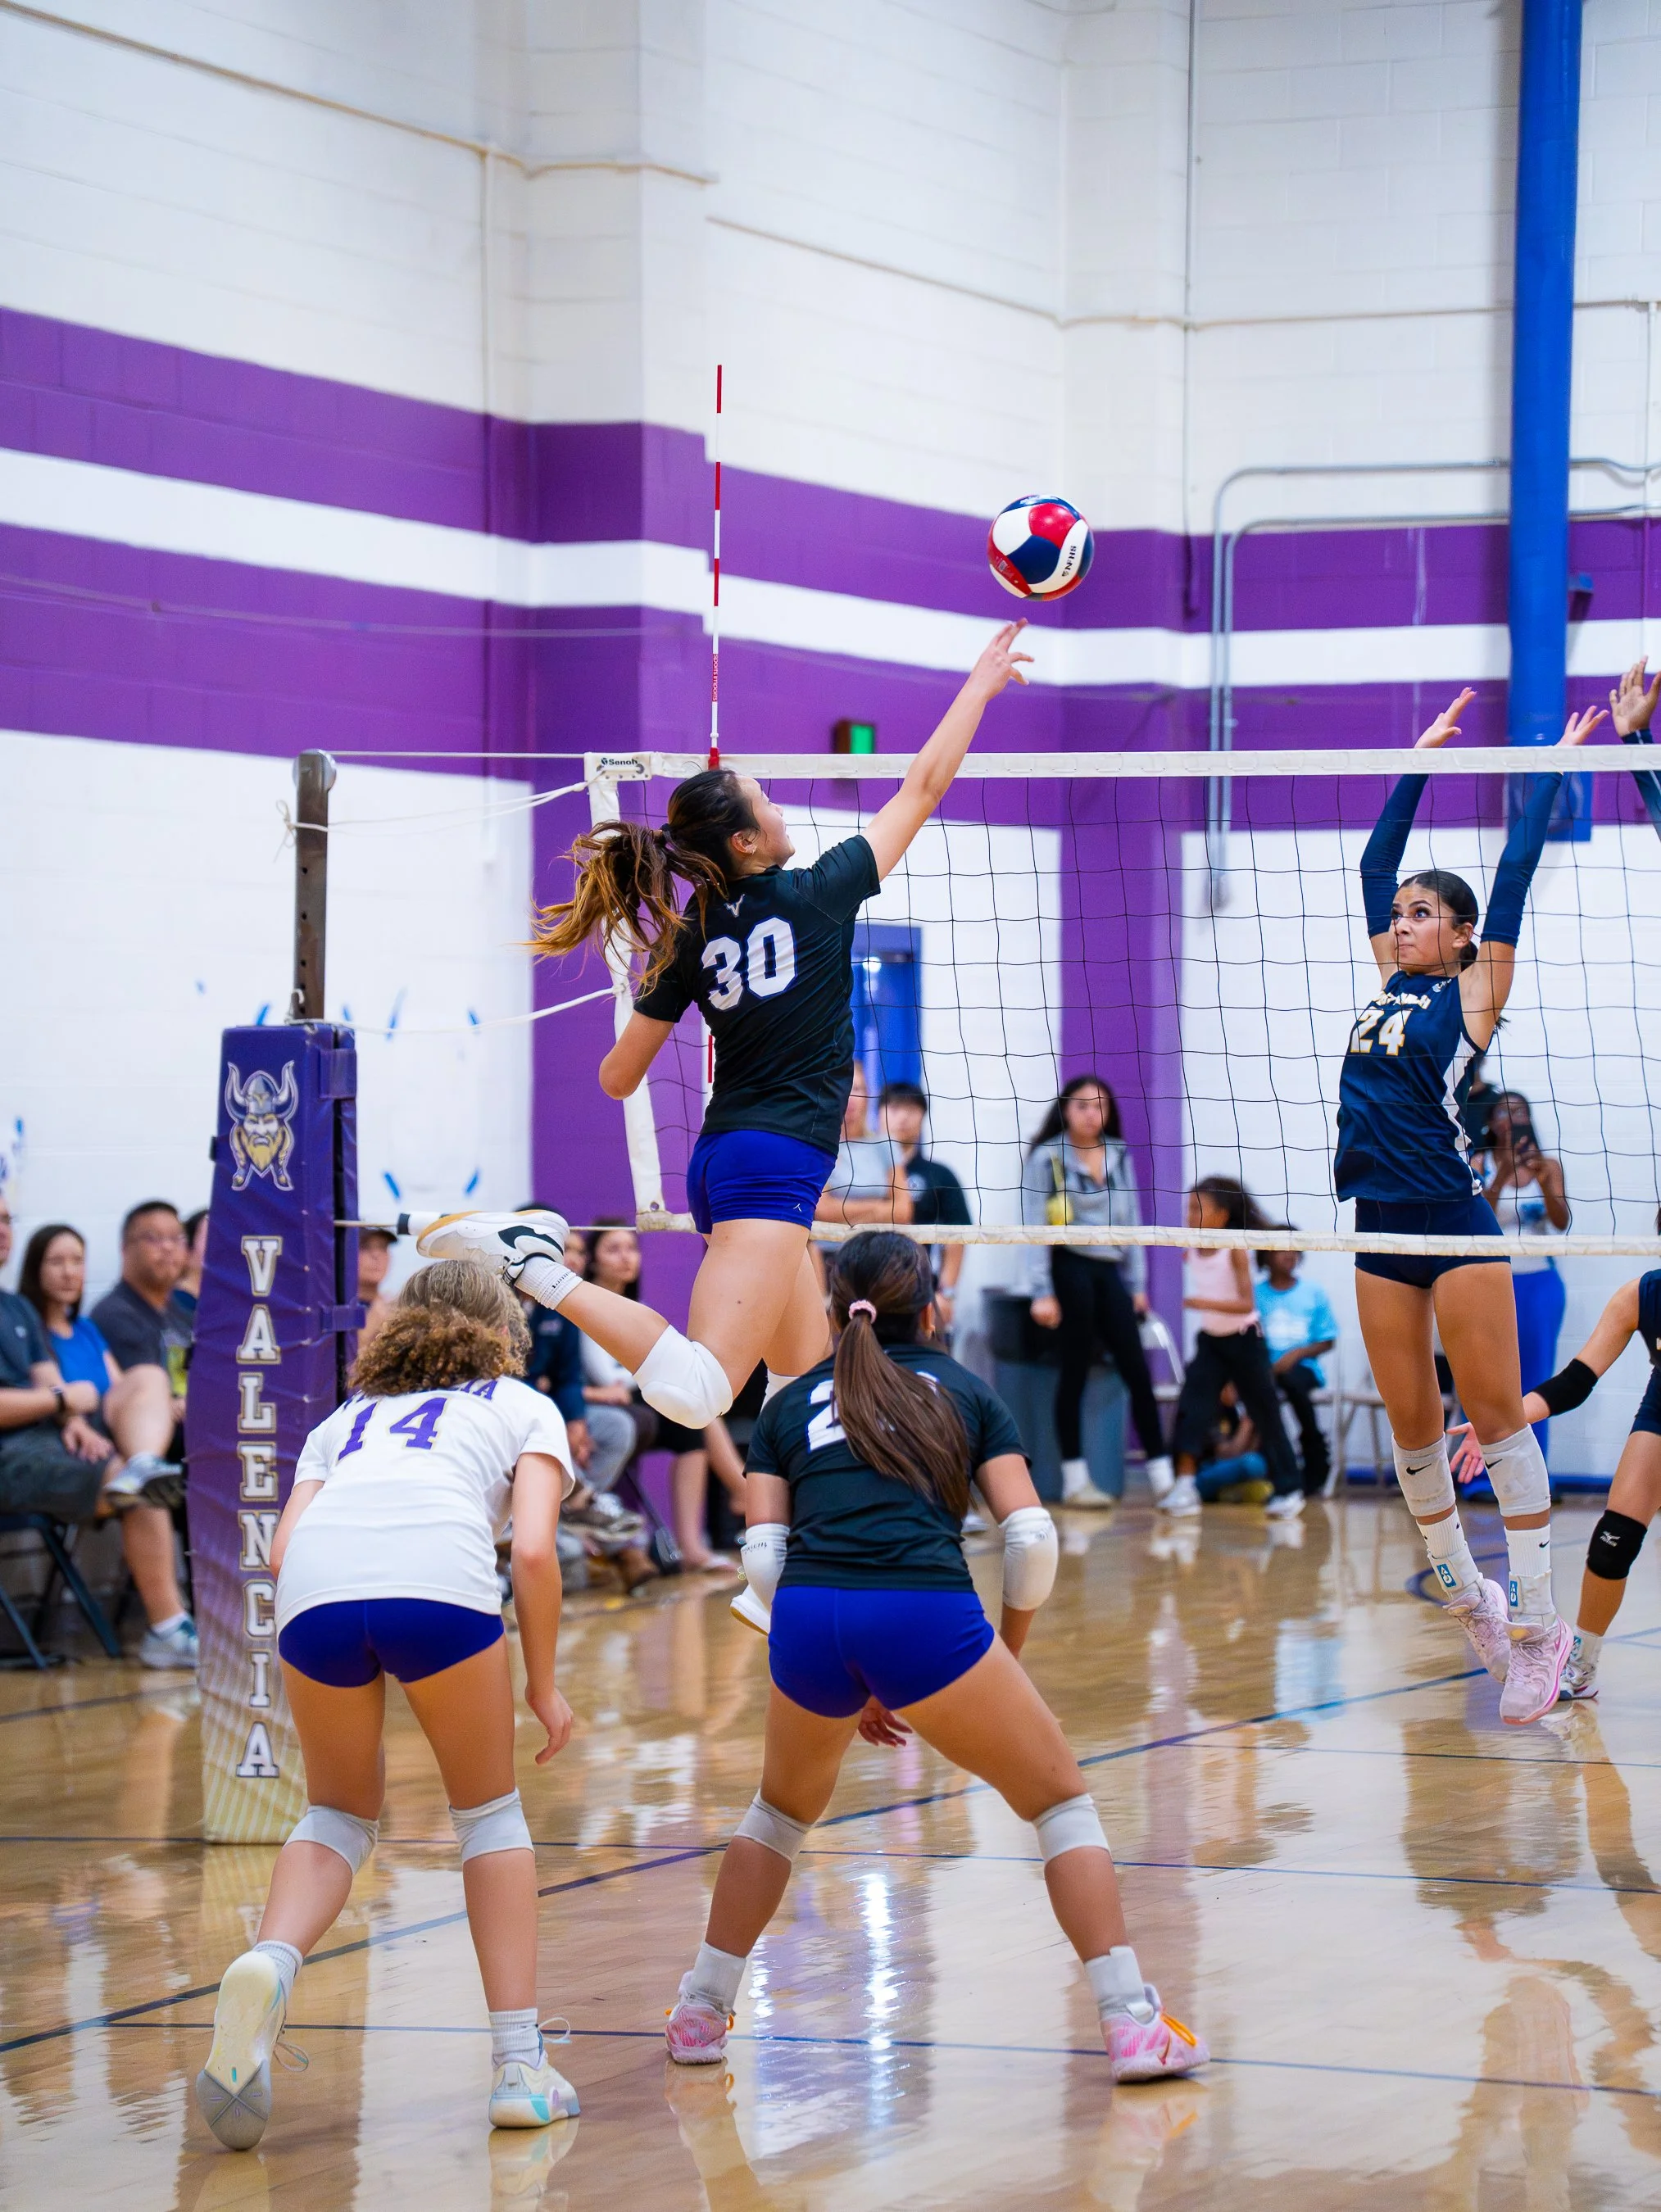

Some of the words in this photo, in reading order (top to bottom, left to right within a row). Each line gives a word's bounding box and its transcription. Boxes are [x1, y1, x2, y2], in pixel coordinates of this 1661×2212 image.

[701, 916, 796, 1010] 30
[1350, 1006, 1413, 1056] 24
[337, 1397, 448, 1462] 14
[236, 1235, 283, 1778] VALENCIA
